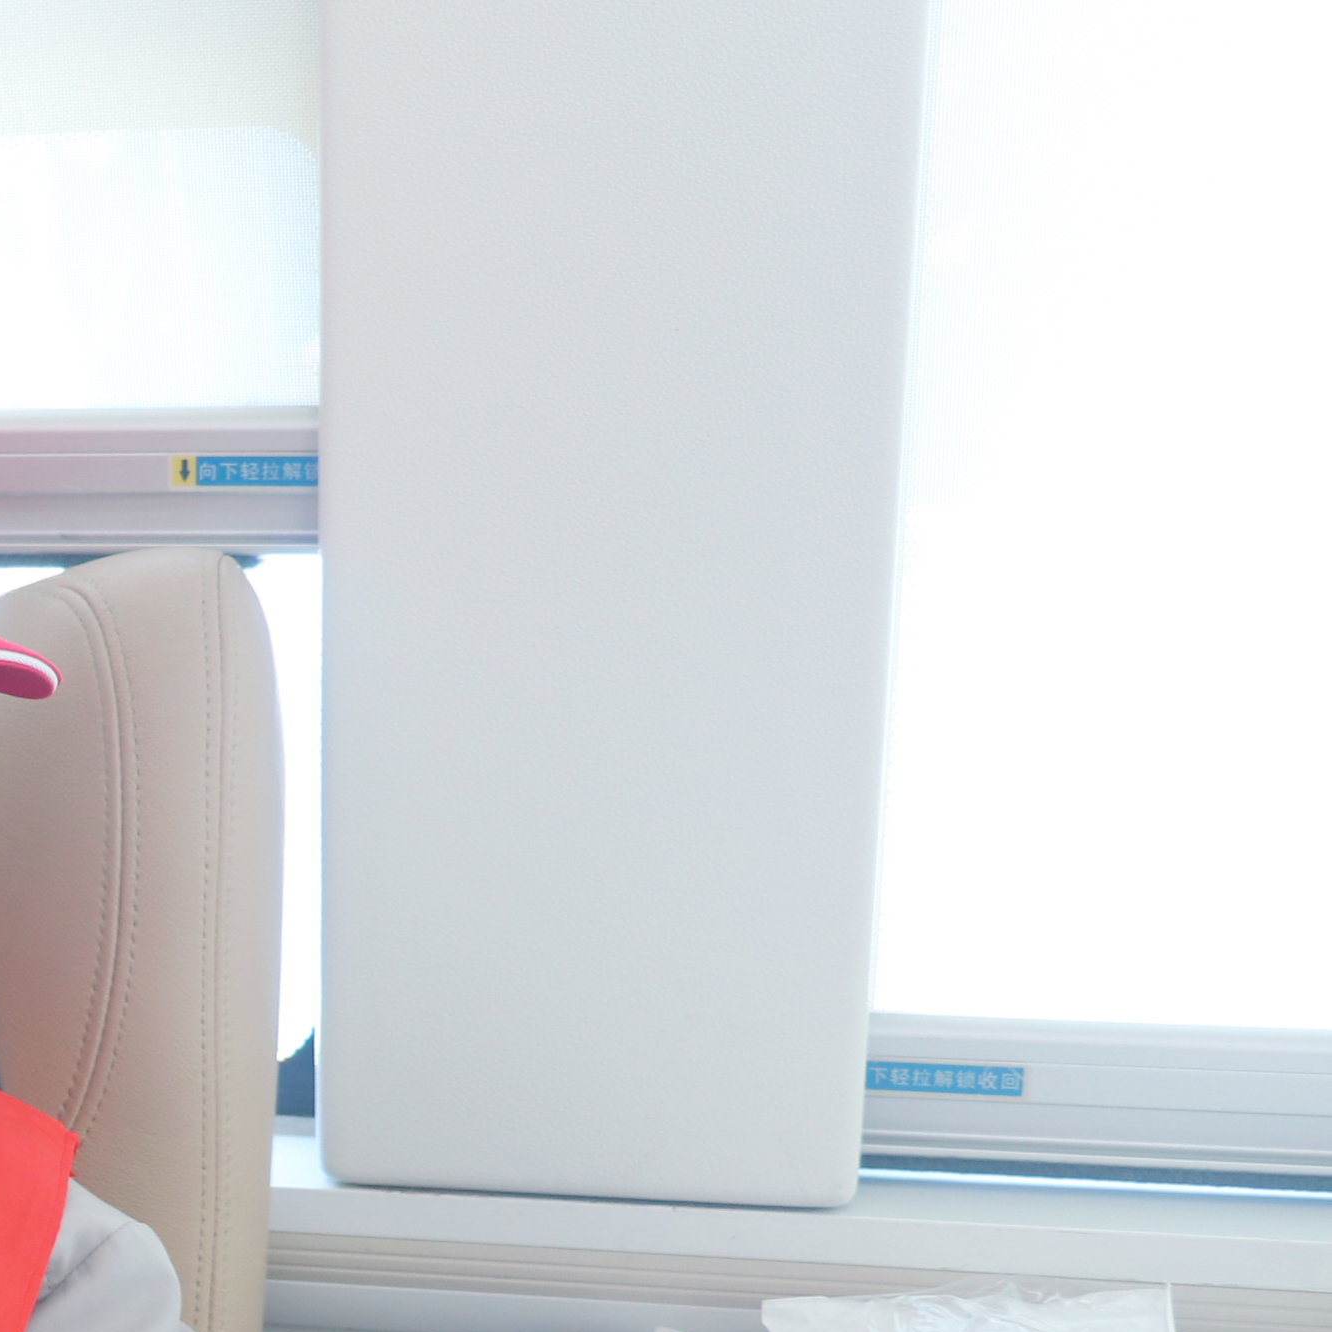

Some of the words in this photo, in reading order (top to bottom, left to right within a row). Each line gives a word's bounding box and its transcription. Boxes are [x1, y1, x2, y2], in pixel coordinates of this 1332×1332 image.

[870, 1067, 1020, 1090] 下轻拉解锁收回
